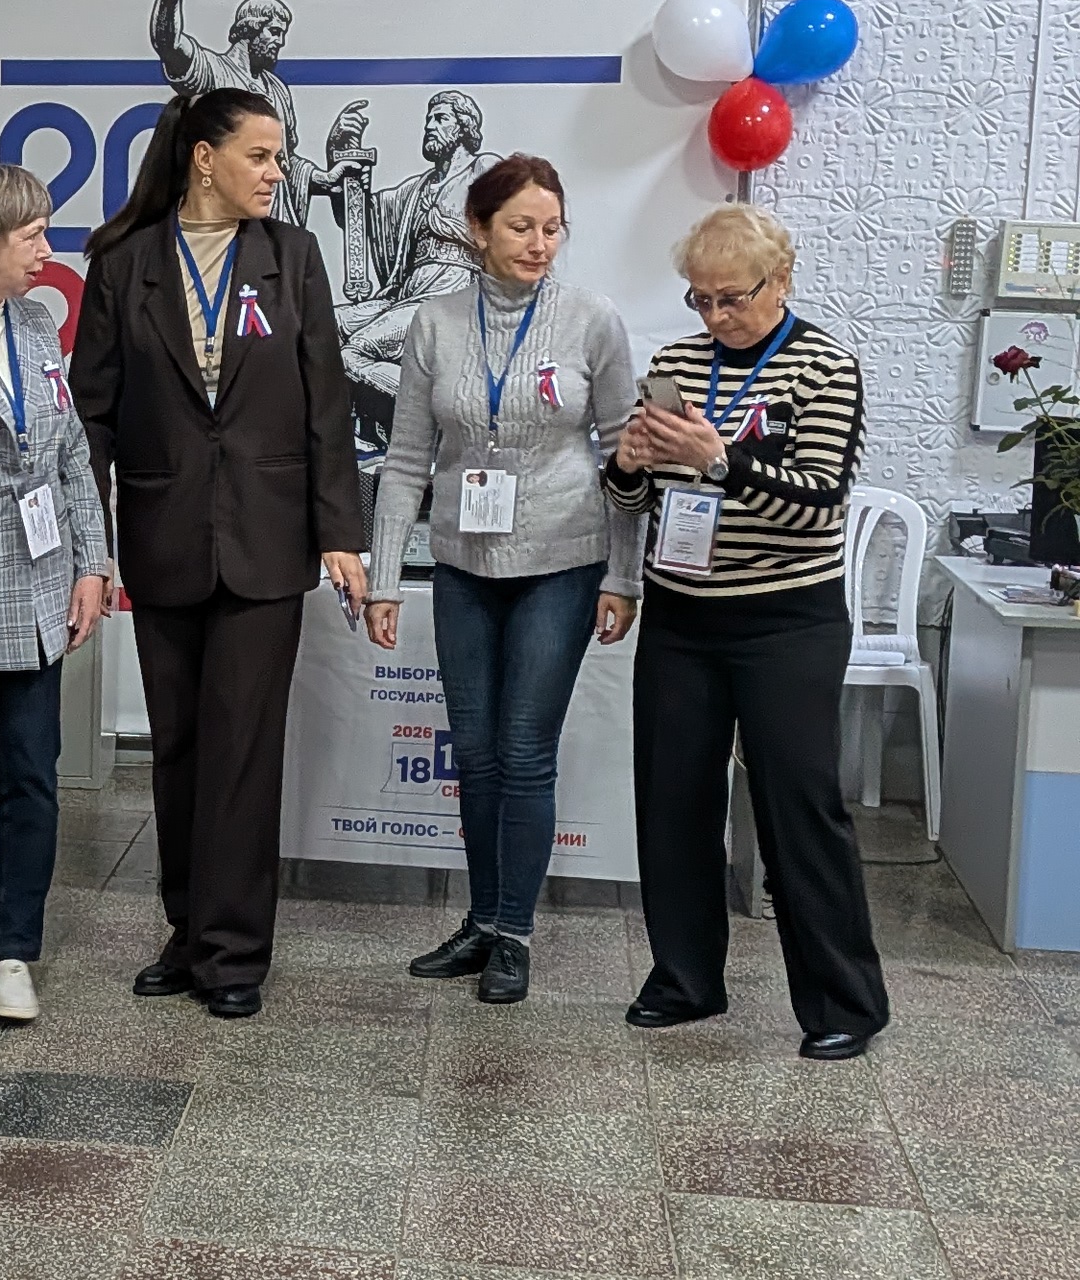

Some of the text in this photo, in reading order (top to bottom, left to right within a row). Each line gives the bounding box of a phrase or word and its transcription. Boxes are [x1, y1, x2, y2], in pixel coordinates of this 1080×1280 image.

[370, 689, 446, 703] ГОСУДАРС
[392, 725, 433, 738] 2026
[396, 743, 459, 783] 18 1
[331, 817, 377, 834] ТВОЙ
[381, 821, 439, 837] ГОЛОС
